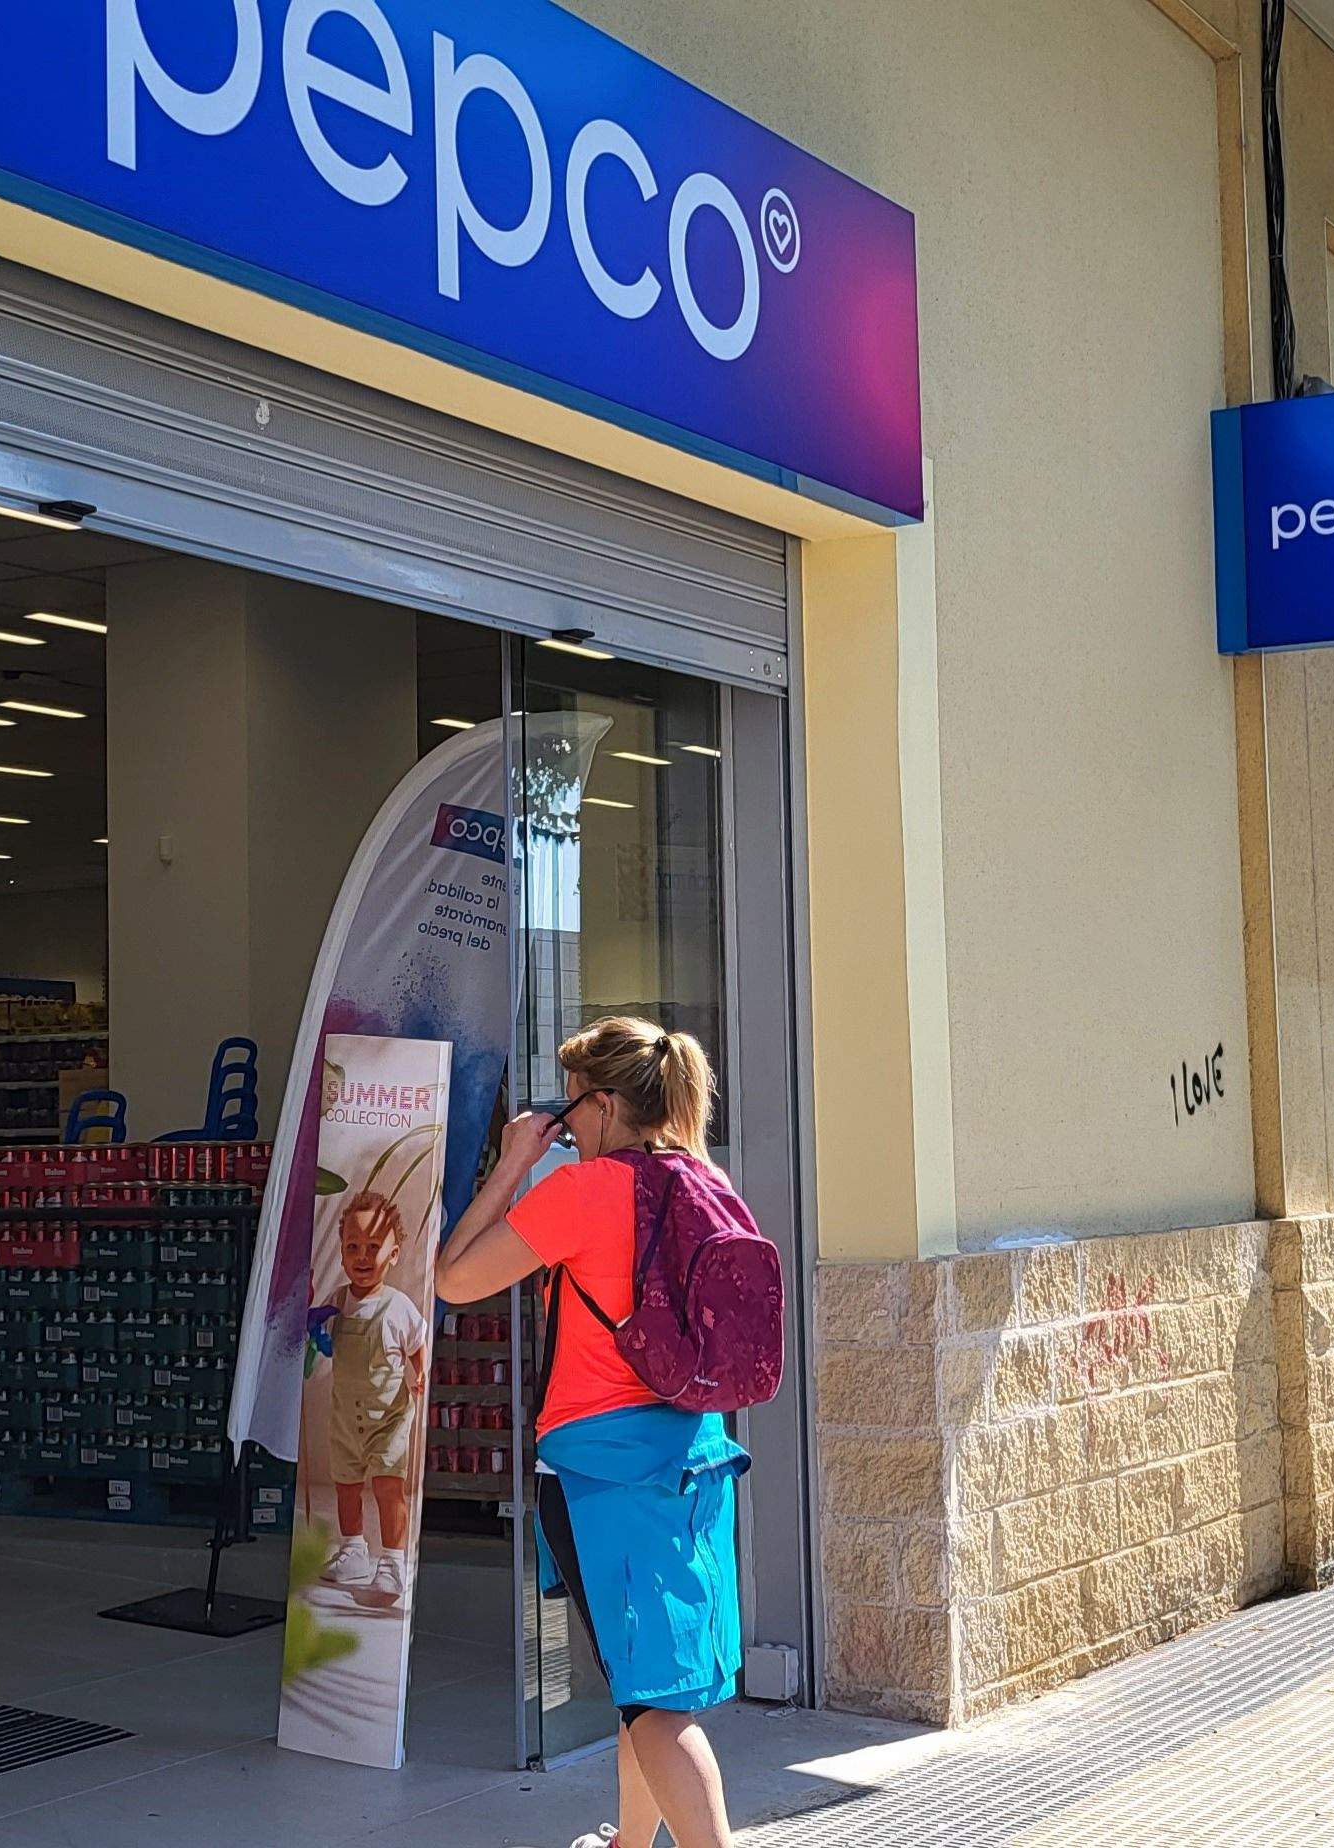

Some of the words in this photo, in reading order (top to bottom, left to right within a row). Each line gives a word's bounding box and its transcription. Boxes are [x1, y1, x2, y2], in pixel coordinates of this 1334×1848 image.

[105, 0, 762, 361] pepco
[326, 1080, 431, 1111] SUMMER
[325, 1108, 412, 1129] COLLECTION
